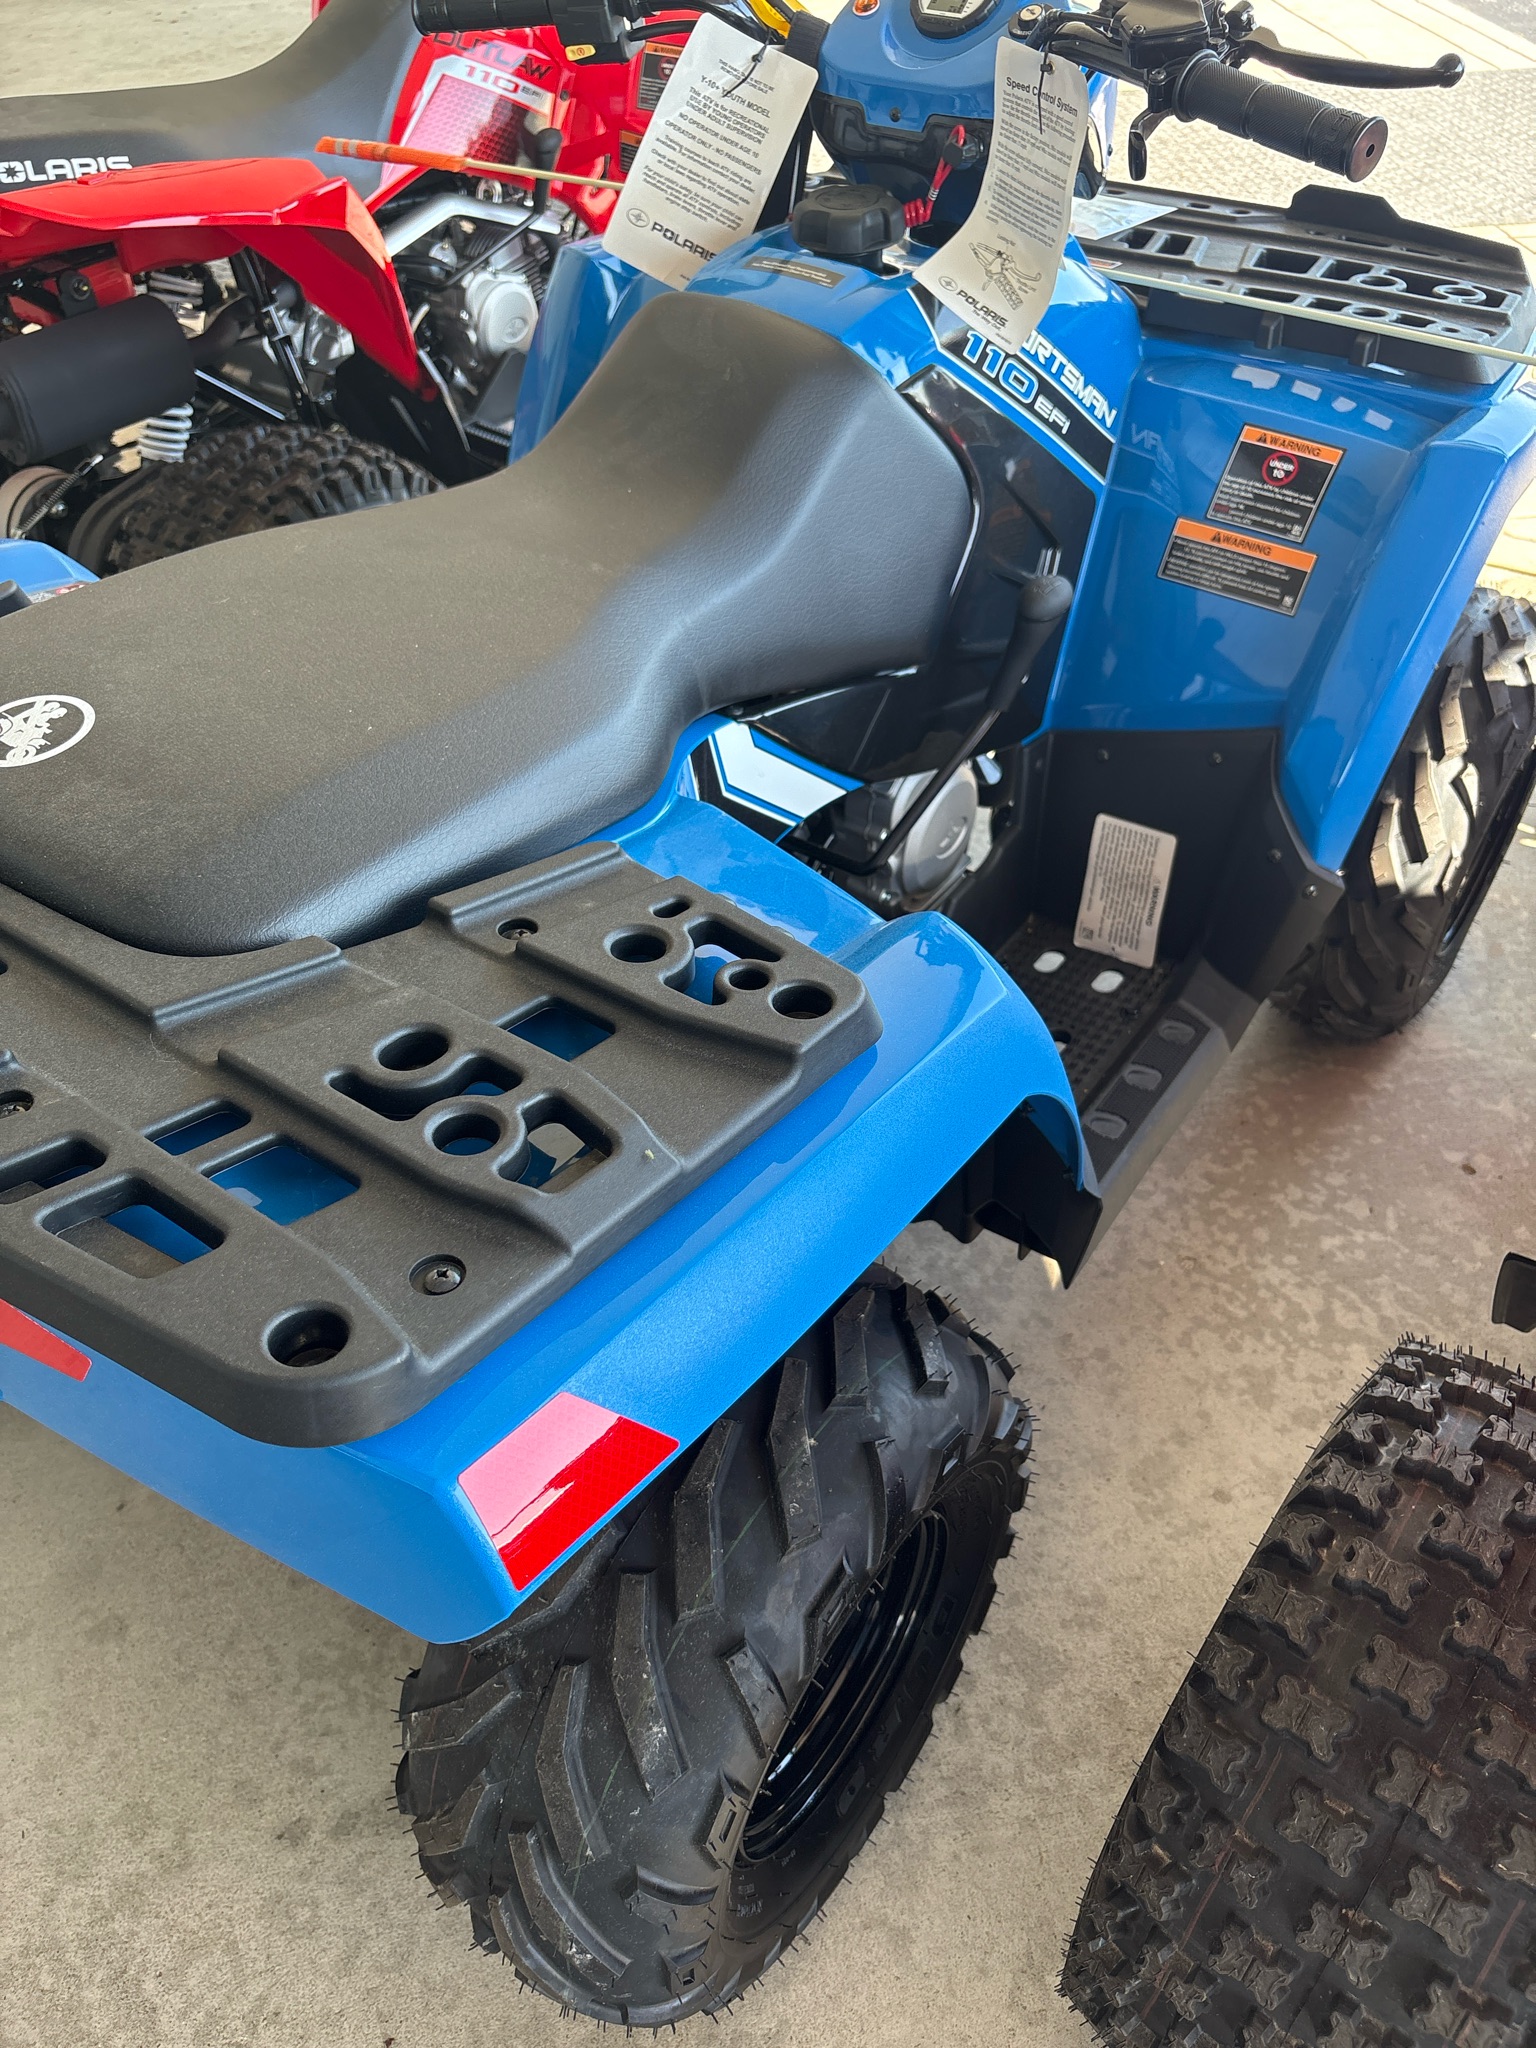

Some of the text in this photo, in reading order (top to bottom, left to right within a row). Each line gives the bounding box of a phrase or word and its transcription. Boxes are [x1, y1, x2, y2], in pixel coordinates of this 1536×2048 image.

[433, 31, 553, 80] OUTLAW
[464, 64, 521, 94] 110
[1006, 76, 1031, 94] Speed
[1032, 85, 1057, 106] Cntrol
[1056, 97, 1078, 118] System
[685, 101, 763, 145] UNDER ADULT SUPERVISION
[689, 95, 766, 139] USE BY YOUNG OPERATORS
[745, 100, 773, 119] MODEL
[664, 119, 698, 141] OPERATOR
[696, 138, 713, 150] ONLY
[715, 147, 725, 156] NO
[724, 152, 763, 176] PASSENGERS
[678, 112, 689, 121] NO
[687, 118, 720, 138] OPERATOR
[719, 134, 739, 149] UNDER
[738, 145, 752, 155] AGE
[0, 156, 133, 184] OLARIS
[956, 289, 1009, 328] POLARIS
[962, 329, 1071, 435] 110 EFI
[1268, 433, 1323, 460] WARNING
[1221, 529, 1274, 559] WARNING
